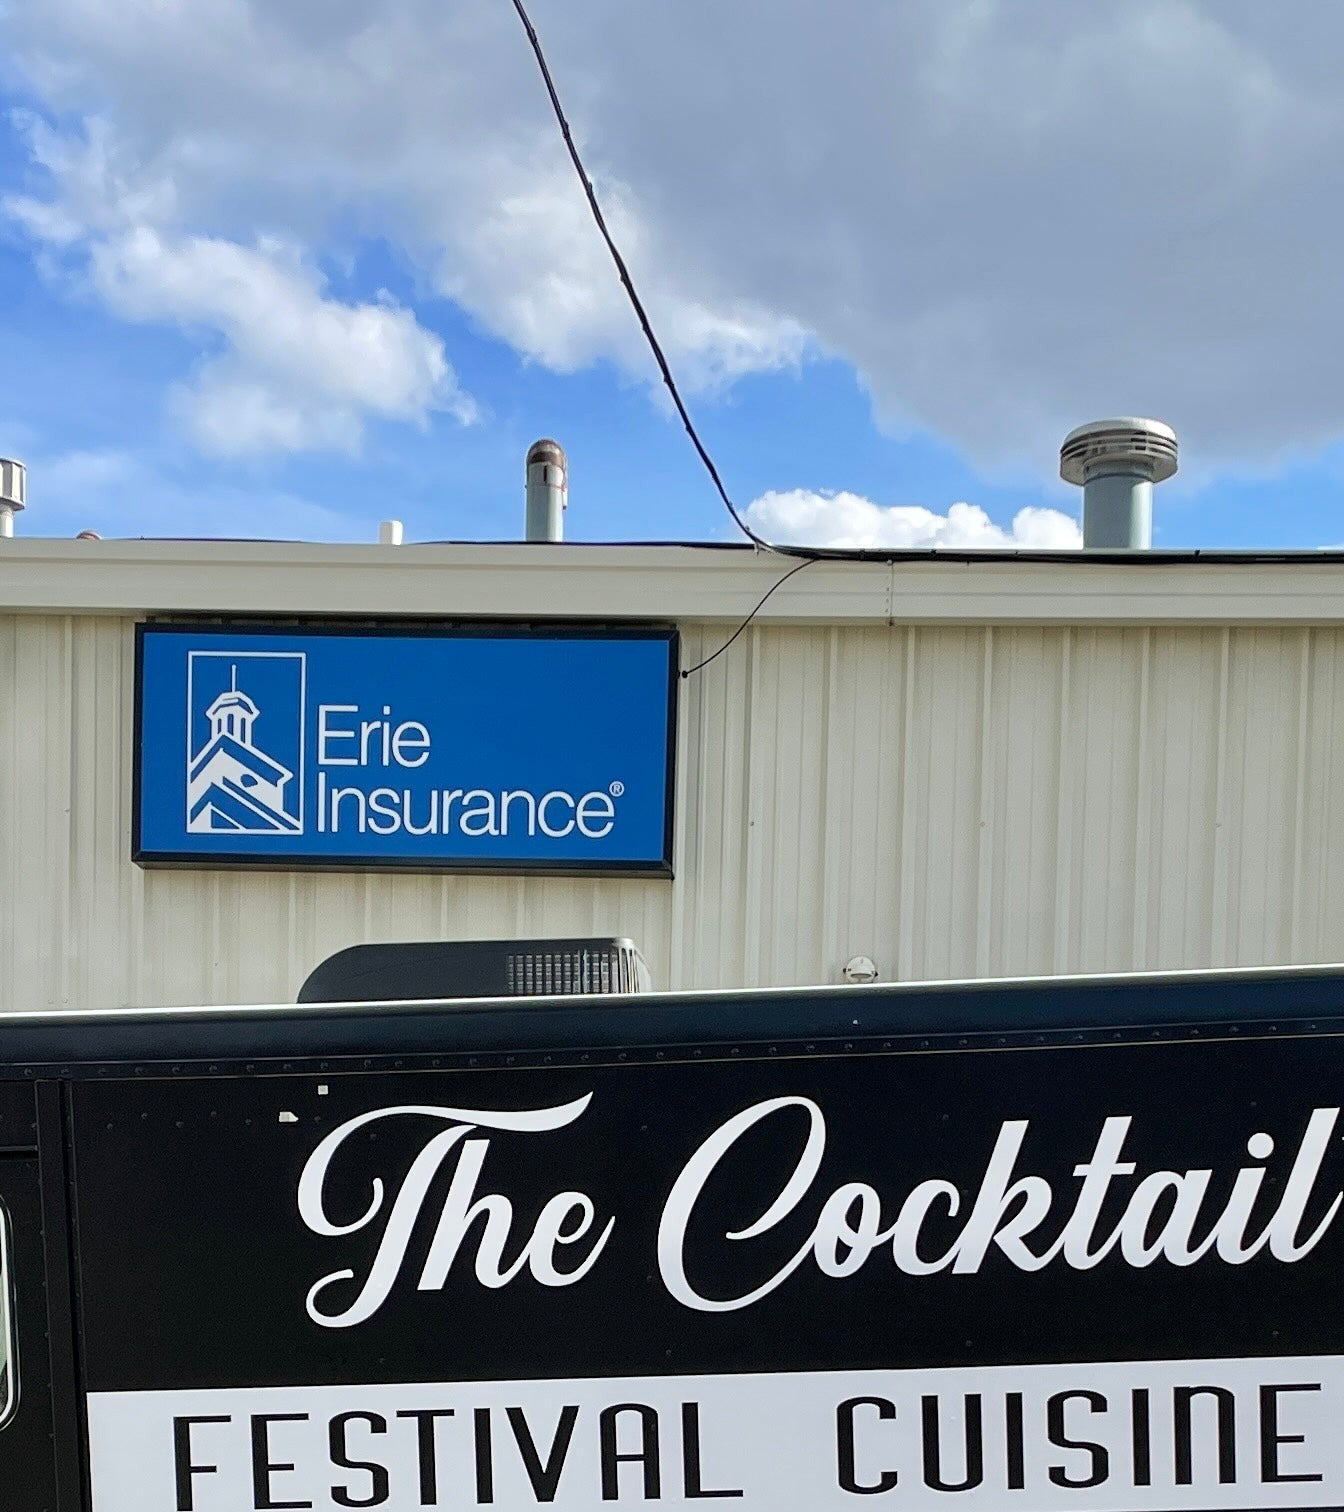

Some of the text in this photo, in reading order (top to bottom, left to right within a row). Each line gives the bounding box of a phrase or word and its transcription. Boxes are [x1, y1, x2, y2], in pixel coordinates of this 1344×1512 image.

[317, 704, 431, 768] Erie
[297, 1091, 616, 1328] The
[657, 1096, 1344, 1313] Cocktail
[173, 1401, 744, 1512] FESTIVAL
[836, 1383, 1323, 1495] CUISINE
